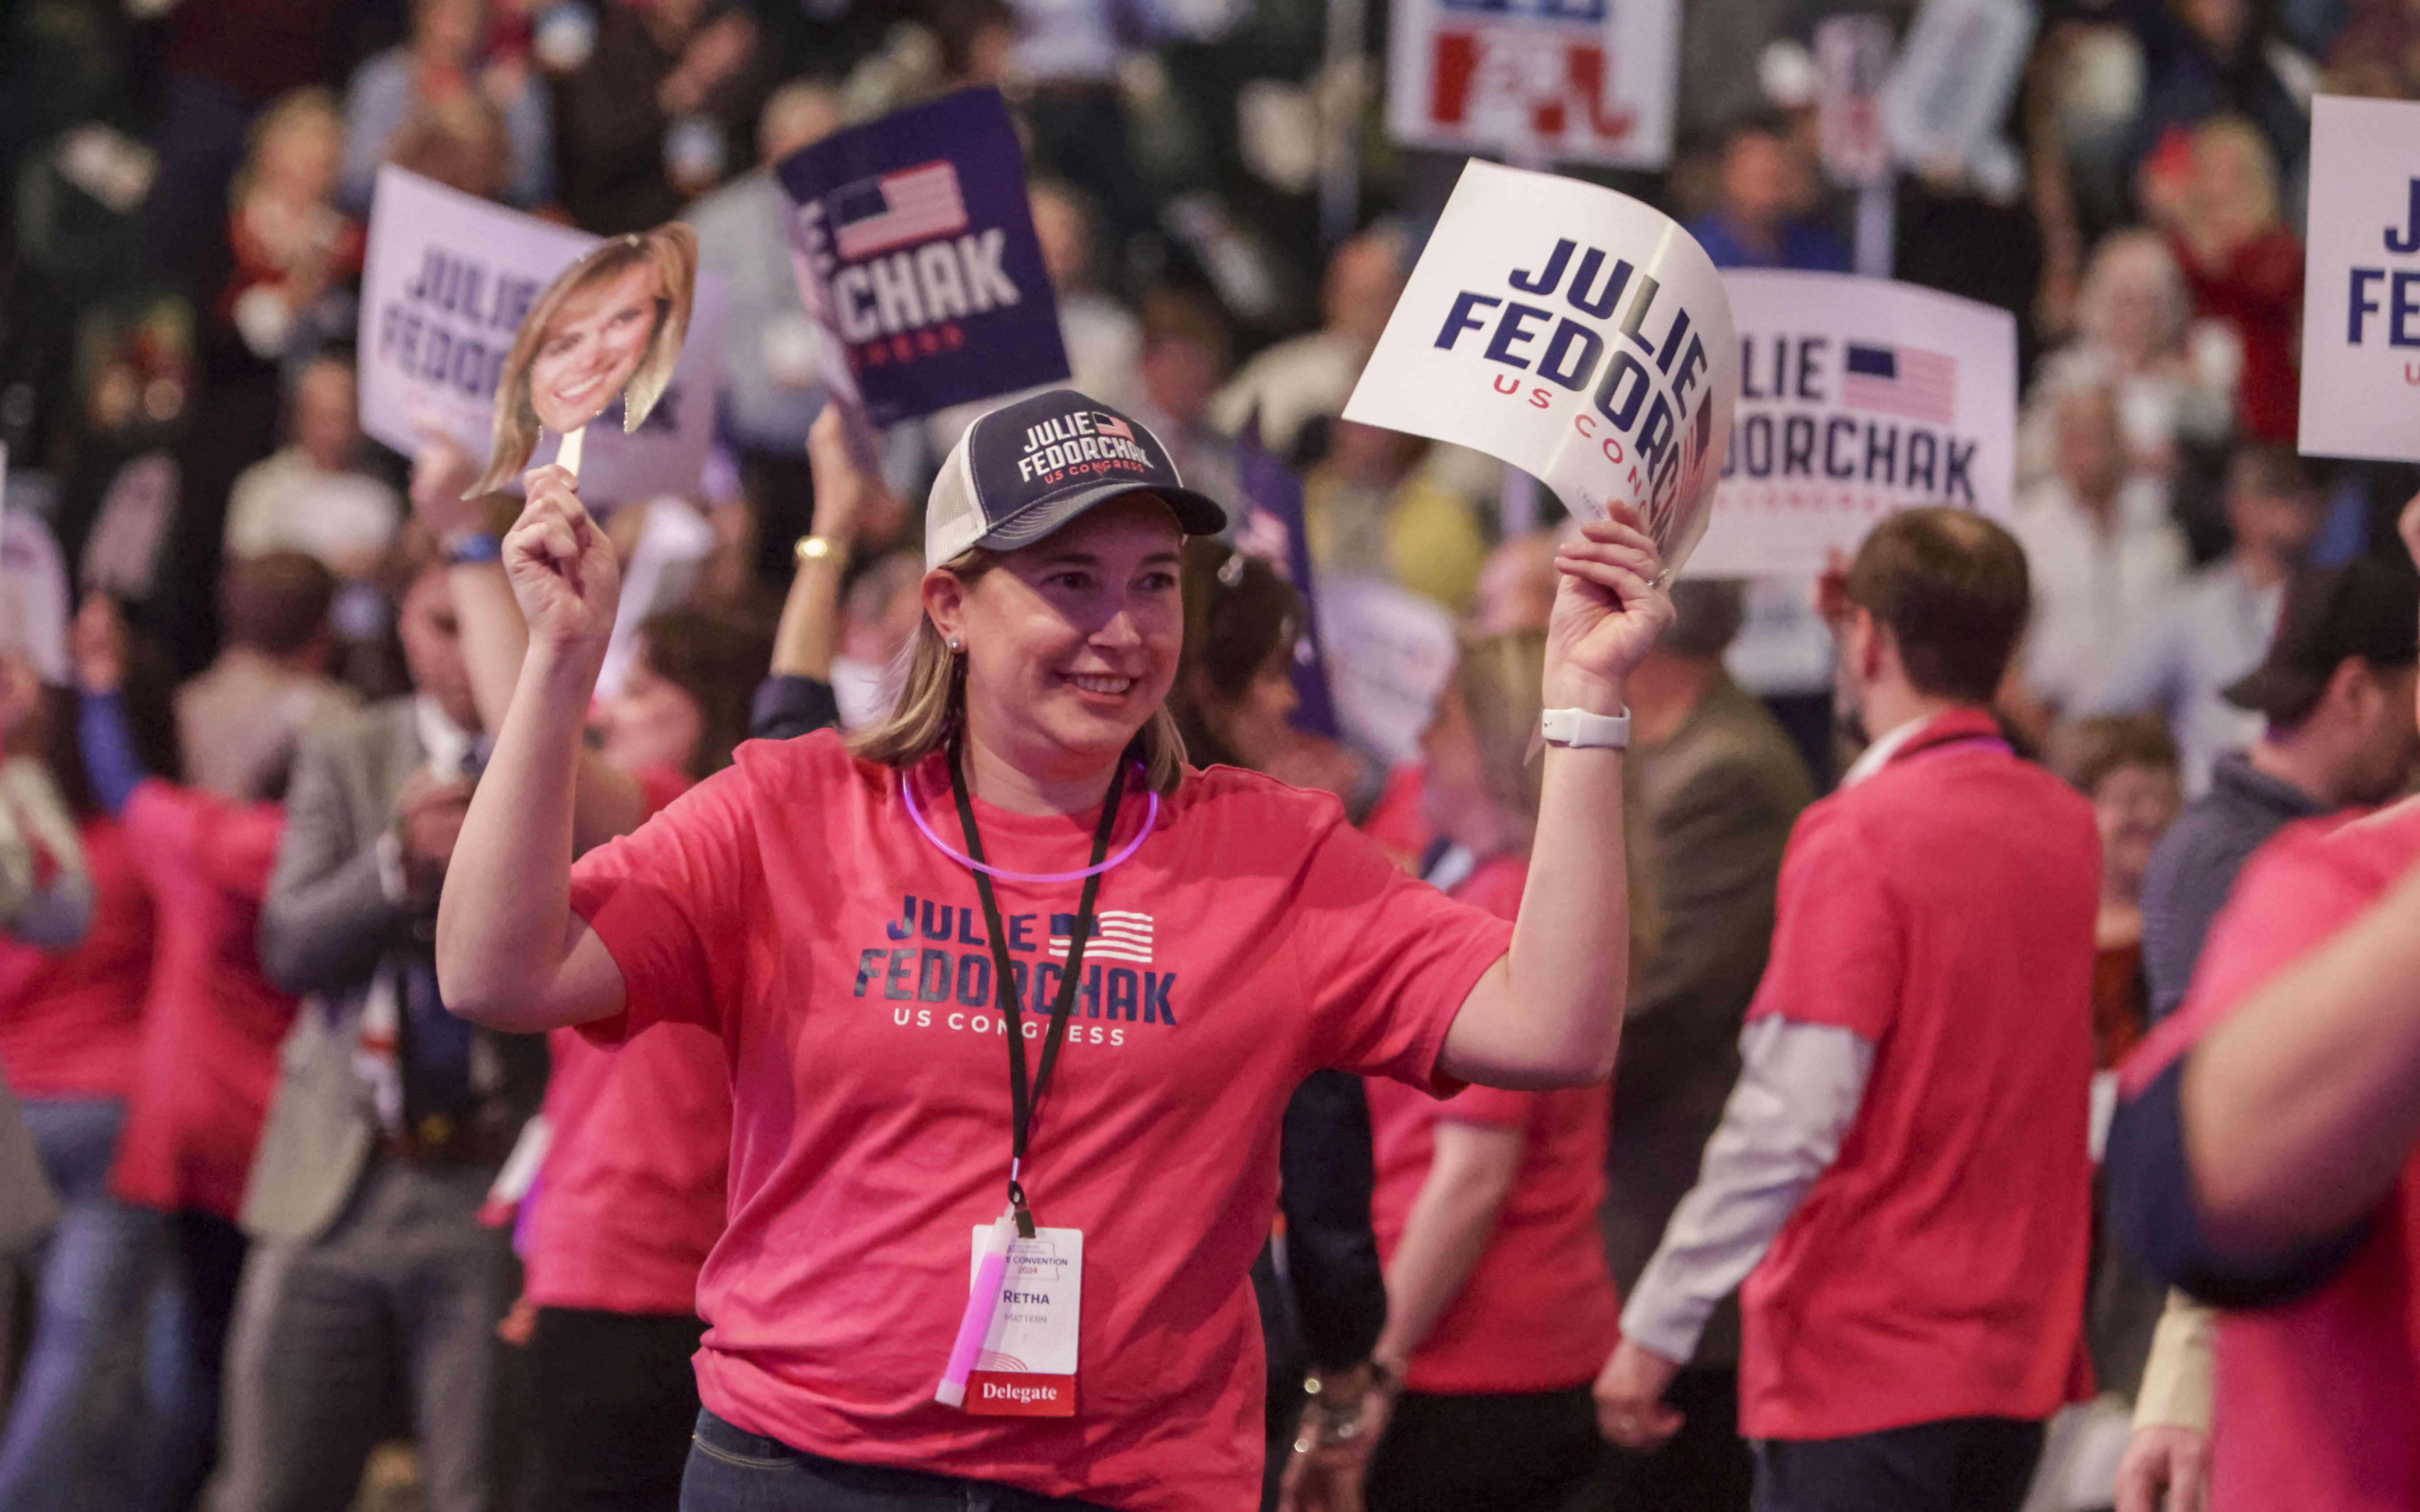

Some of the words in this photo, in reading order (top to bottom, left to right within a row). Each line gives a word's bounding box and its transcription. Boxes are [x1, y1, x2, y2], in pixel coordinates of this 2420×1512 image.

[831, 228, 1021, 344] CHAK
[1509, 237, 1707, 420] JULIE
[1741, 336, 1829, 401] LIE
[1493, 374, 1552, 409] US
[1023, 411, 1095, 453] JULIE
[1018, 437, 1154, 482] FEDORCHAK
[1044, 470, 1064, 484] US
[1720, 413, 1978, 503] ORCHAK
[887, 895, 1038, 952] JULE
[893, 1008, 931, 1027] US
[947, 1012, 1125, 1046] CONGESS
[1013, 1256, 1068, 1266] CONVENTION
[1003, 1290, 1049, 1305] RETHA
[983, 1382, 1057, 1403] Delegate
